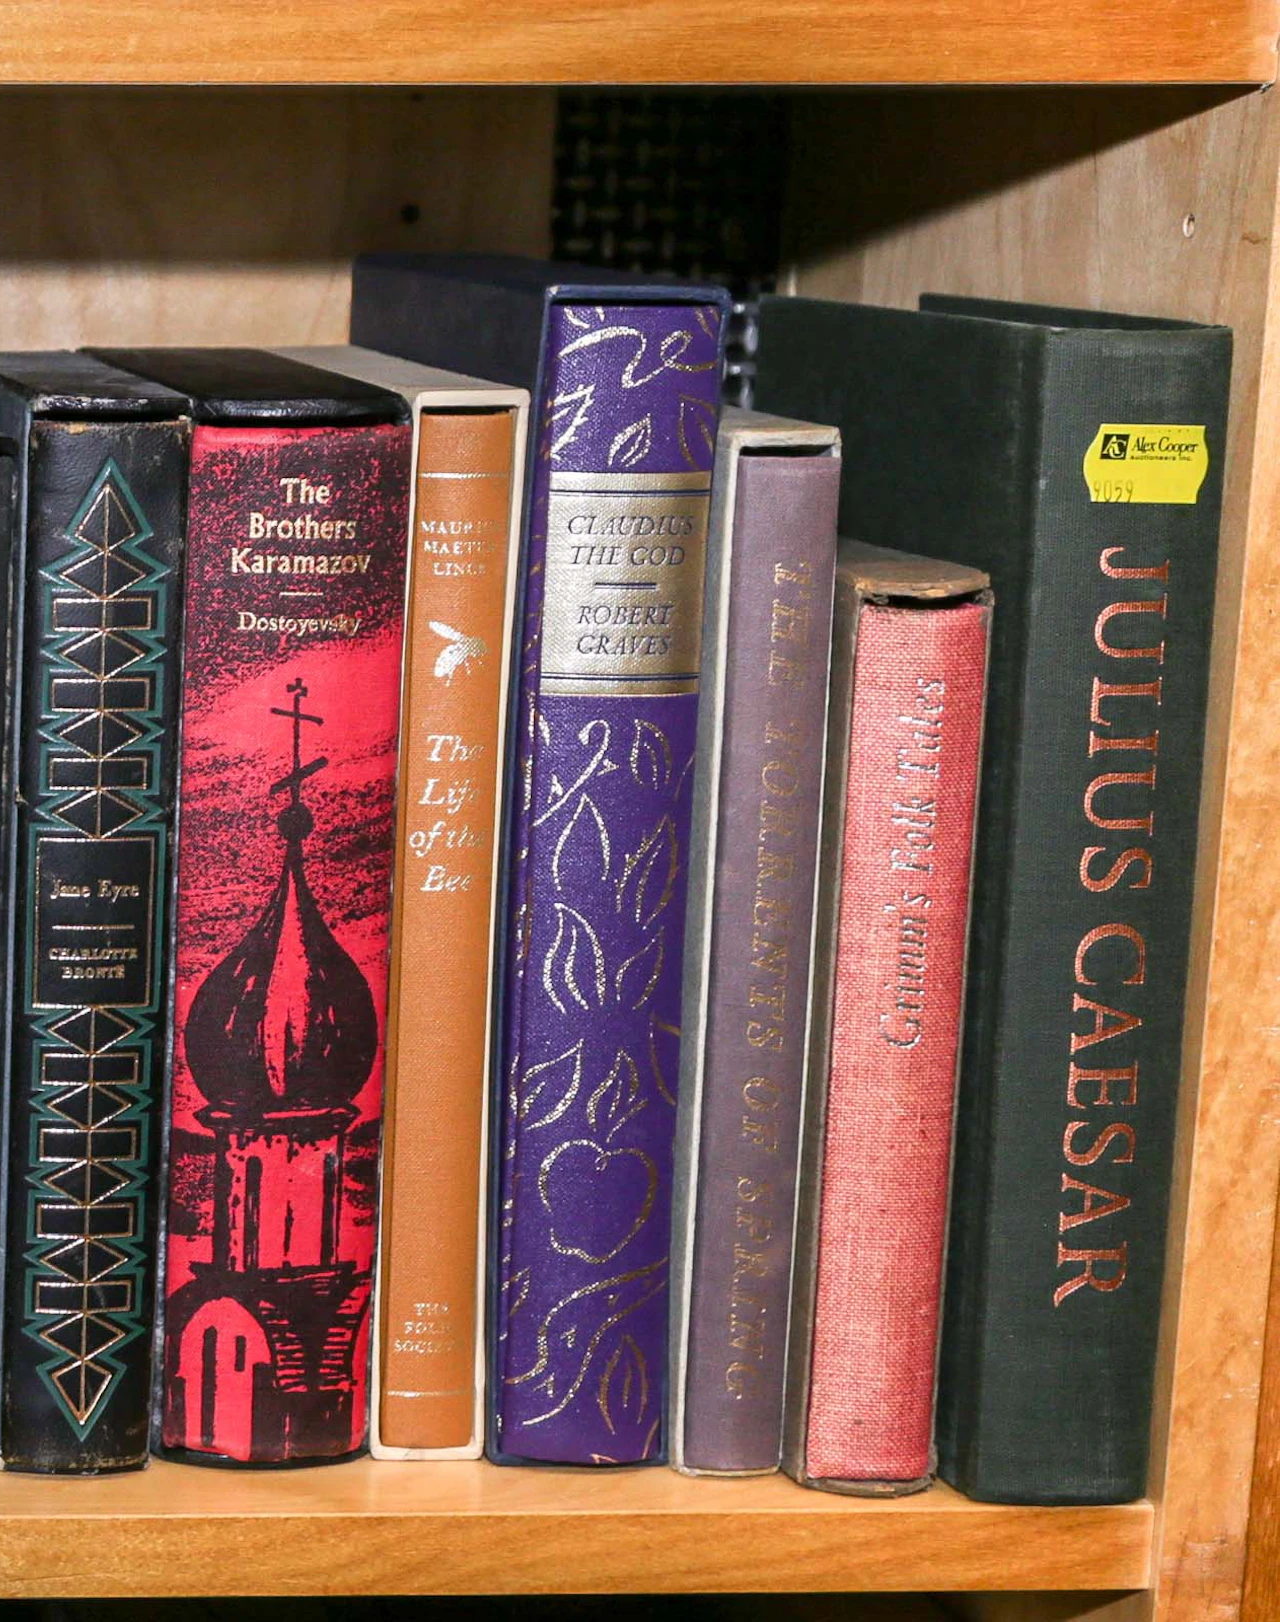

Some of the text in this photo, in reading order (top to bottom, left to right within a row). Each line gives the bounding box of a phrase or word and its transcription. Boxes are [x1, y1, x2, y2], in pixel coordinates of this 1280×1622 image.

[1132, 436, 1198, 456] Alex Cooper
[280, 478, 330, 505] The
[1093, 480, 1133, 503] 9059
[249, 514, 356, 539] Brothers
[567, 515, 694, 537] CLAUDIUS
[231, 549, 370, 575] Karamazov
[571, 547, 685, 566] THE GOD
[238, 613, 361, 637] Dostoyevsky
[578, 605, 673, 626] ROBERT
[768, 558, 810, 690] THE
[577, 635, 671, 656] GRAVES
[409, 821, 446, 858] of
[880, 677, 946, 1049] Grimm's Folk Tales
[50, 878, 139, 903] Jane Eyre
[1054, 547, 1169, 1308] JULIUS CAESAR
[49, 948, 138, 960] CHARLOTTE
